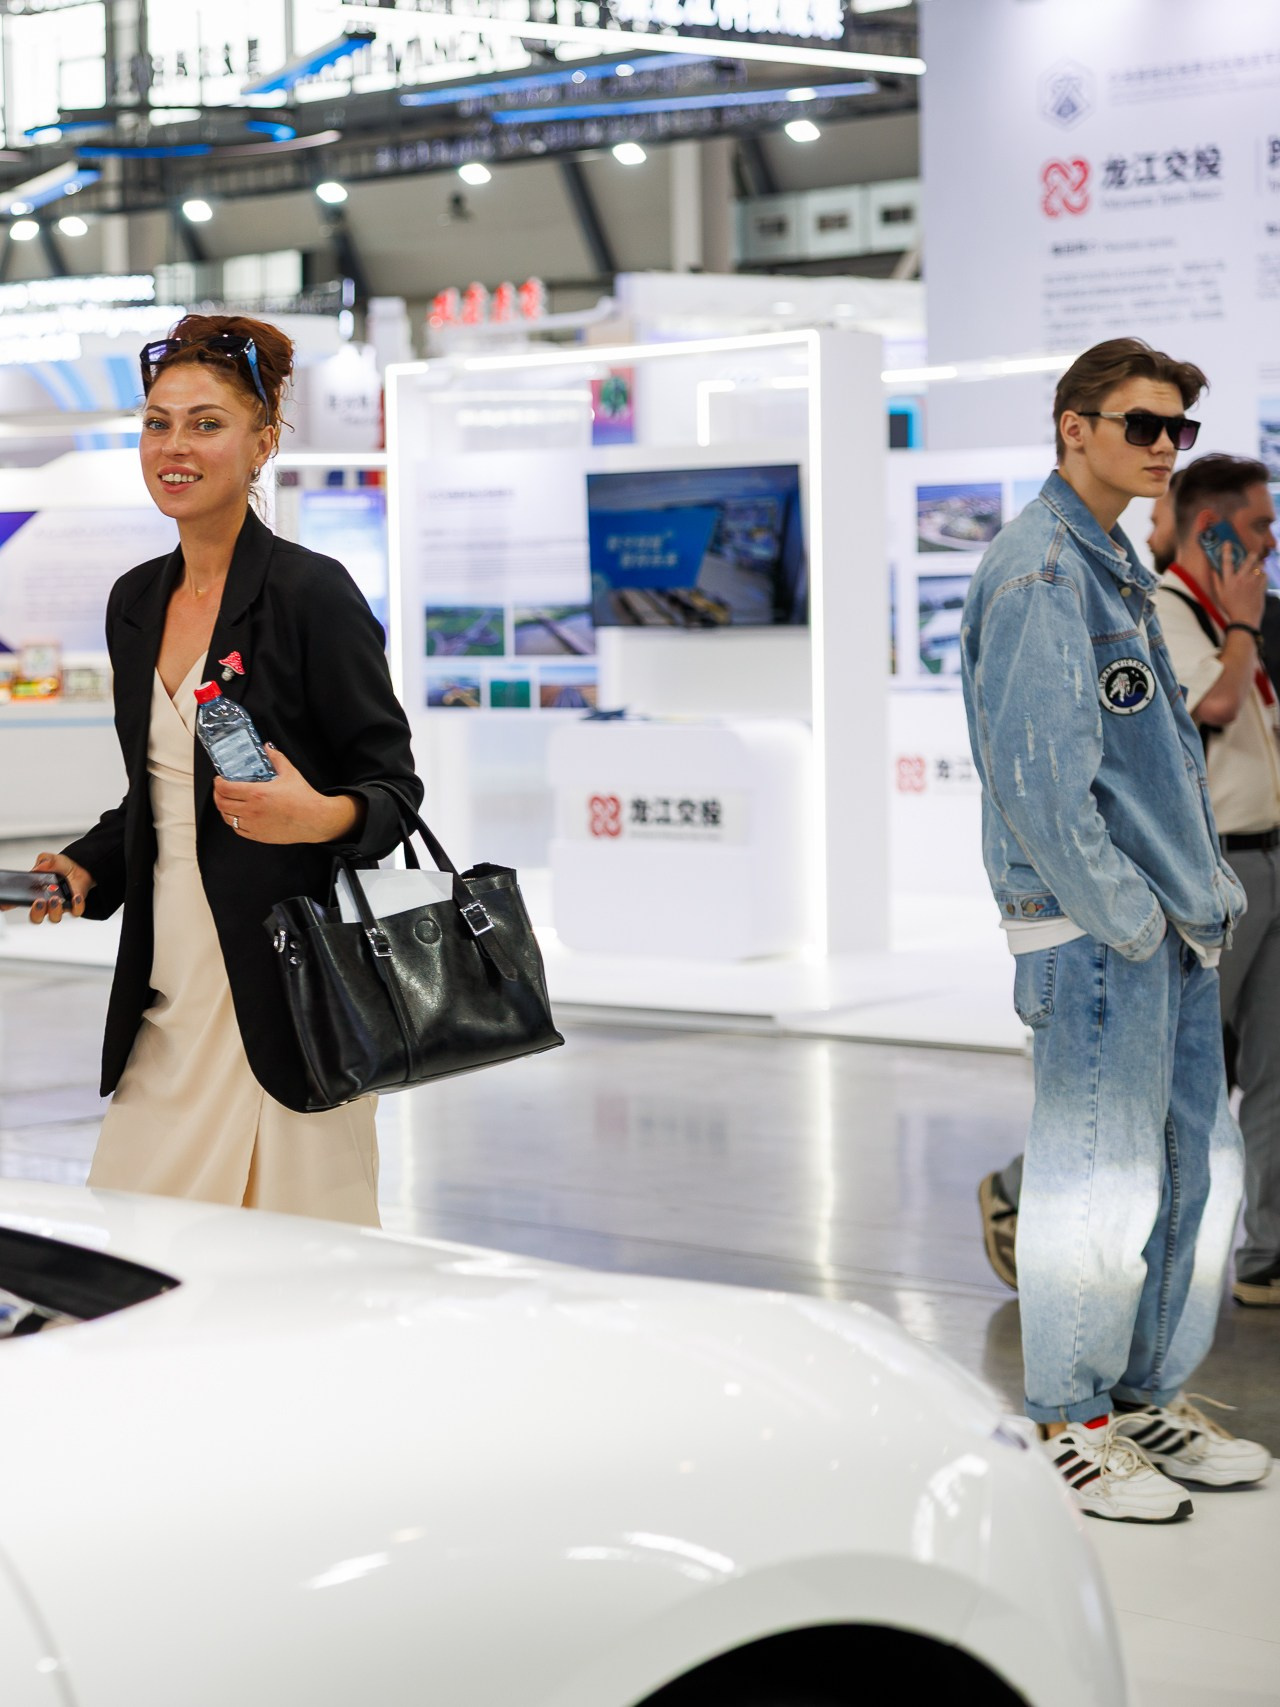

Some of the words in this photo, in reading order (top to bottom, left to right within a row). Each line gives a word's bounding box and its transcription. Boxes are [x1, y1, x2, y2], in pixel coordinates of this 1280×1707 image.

[1101, 142, 1222, 188] 龙江交投
[630, 796, 722, 826] 龙江交投
